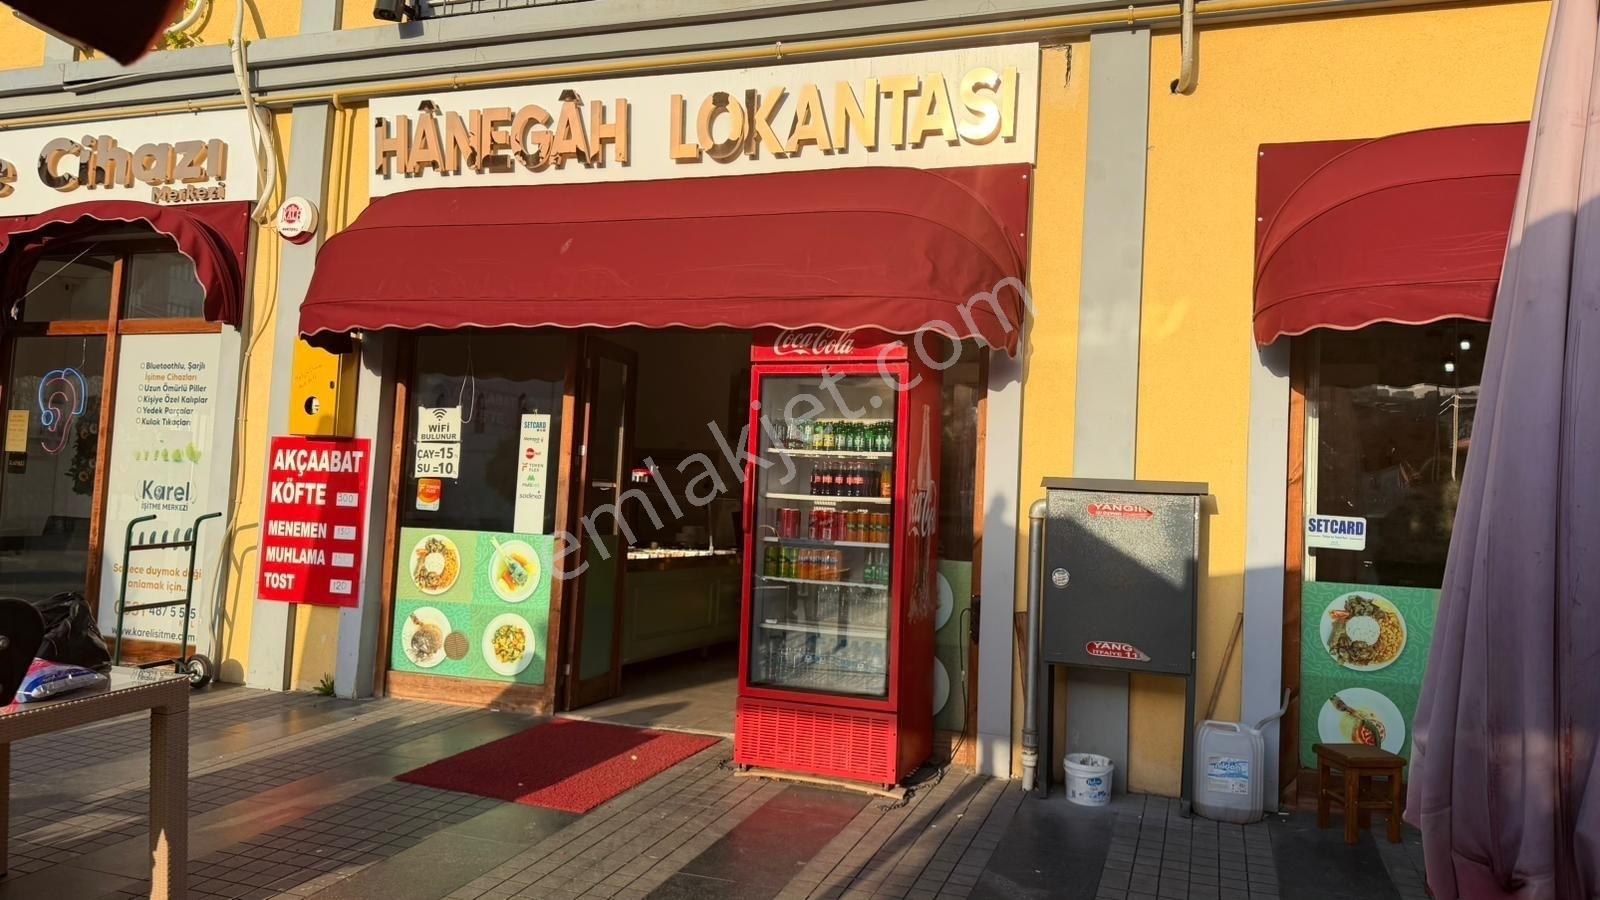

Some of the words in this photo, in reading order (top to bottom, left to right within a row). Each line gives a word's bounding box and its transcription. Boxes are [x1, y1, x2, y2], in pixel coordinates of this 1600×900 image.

[375, 89, 628, 178] HÂNEGÂH
[669, 66, 1018, 164] LOKANTASI
[151, 182, 226, 203] Merkezi
[773, 327, 854, 356] Coca-Cola
[144, 384, 162, 393] Uzun
[162, 382, 188, 393] Ömürlü
[188, 384, 207, 393] Piller
[143, 395, 163, 406] Kişiye
[163, 394, 180, 404] Özel
[180, 395, 208, 406] Kalıplar
[143, 406, 163, 415] Yedek
[164, 406, 194, 418] Parçalar
[141, 417, 161, 426] Kulak
[428, 422, 450, 433] WİFİ
[417, 447, 454, 461] ÇAY=15
[273, 448, 364, 477] AKÇAABAT
[417, 463, 430, 473] SU
[142, 480, 190, 501] Karel
[271, 477, 327, 505] KÖFTE
[141, 501, 161, 511] İŞİTME
[162, 502, 188, 511] MERKEZİ
[268, 519, 327, 539] MENEMEN
[1308, 518, 1364, 536] SETCARD
[265, 546, 326, 566] MUHLAMA
[113, 563, 144, 574] Saece
[146, 566, 180, 578] duymak
[128, 579, 166, 591] anlamak
[264, 572, 295, 590] TOST
